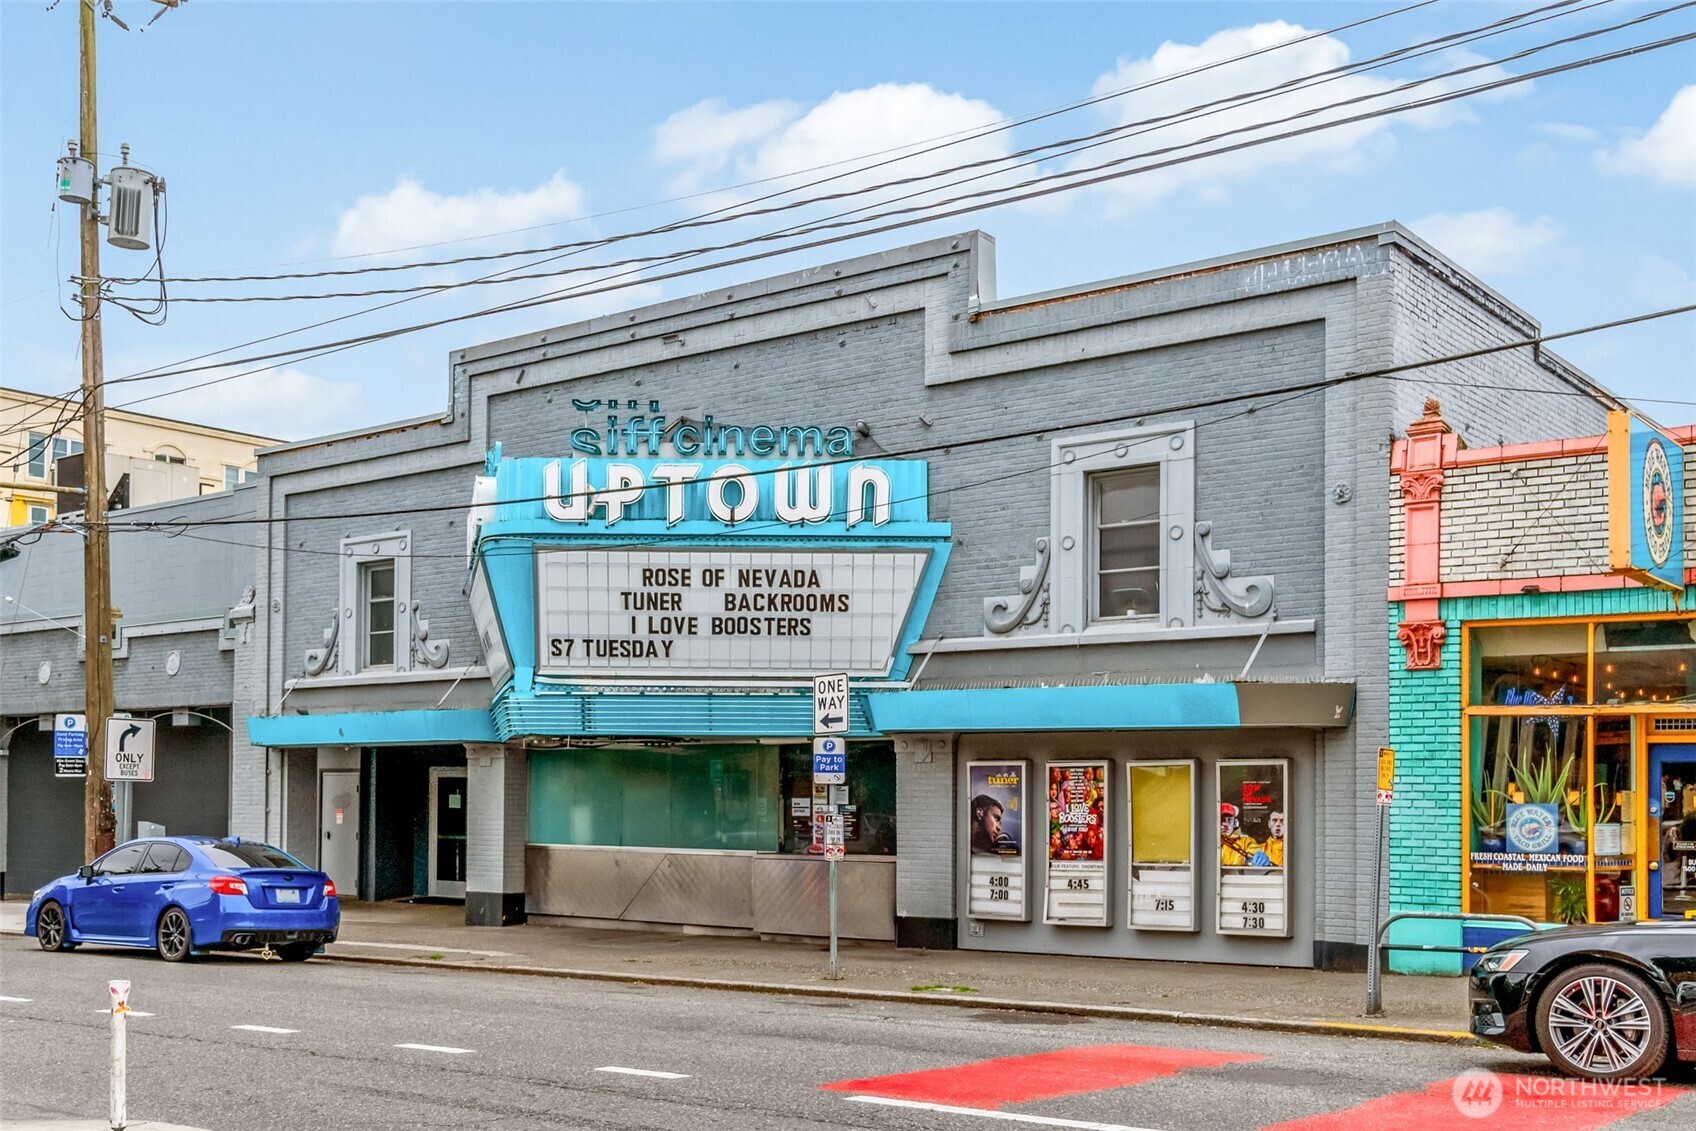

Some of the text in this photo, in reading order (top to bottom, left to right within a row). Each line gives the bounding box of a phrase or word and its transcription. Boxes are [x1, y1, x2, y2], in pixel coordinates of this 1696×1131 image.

[571, 414, 853, 456] siff cinema
[543, 458, 892, 528] UPTOWN
[642, 568, 821, 589] ROSE OF NEVADA
[621, 592, 849, 613] TUNER BACKROOMS
[631, 616, 811, 637] I LOVE BOOSTERS
[551, 639, 674, 658] S7 TUESDAY
[818, 679, 844, 694] ONE
[818, 695, 845, 710] WAY
[115, 753, 144, 763] ONLY
[816, 755, 842, 764] Pay to
[120, 769, 139, 777] BUSES
[819, 763, 839, 771] Park
[988, 775, 1019, 785] tuner
[1071, 802, 1089, 814] LOVE
[1059, 812, 1097, 825] BOOSTERS
[1510, 808, 1552, 828] BLUE WATER
[1513, 834, 1553, 849] TACO GRILL
[1470, 852, 1584, 863] FRESH COASTAL MEXICAN FOOD
[1502, 862, 1548, 872] MADE DAILY
[989, 876, 1009, 887] 4:00
[1067, 879, 1089, 889] 4:45
[990, 889, 1009, 900] 7:00
[1155, 899, 1174, 911] 7:15
[1241, 902, 1265, 913] 4:30
[1242, 917, 1265, 929] 7:30
